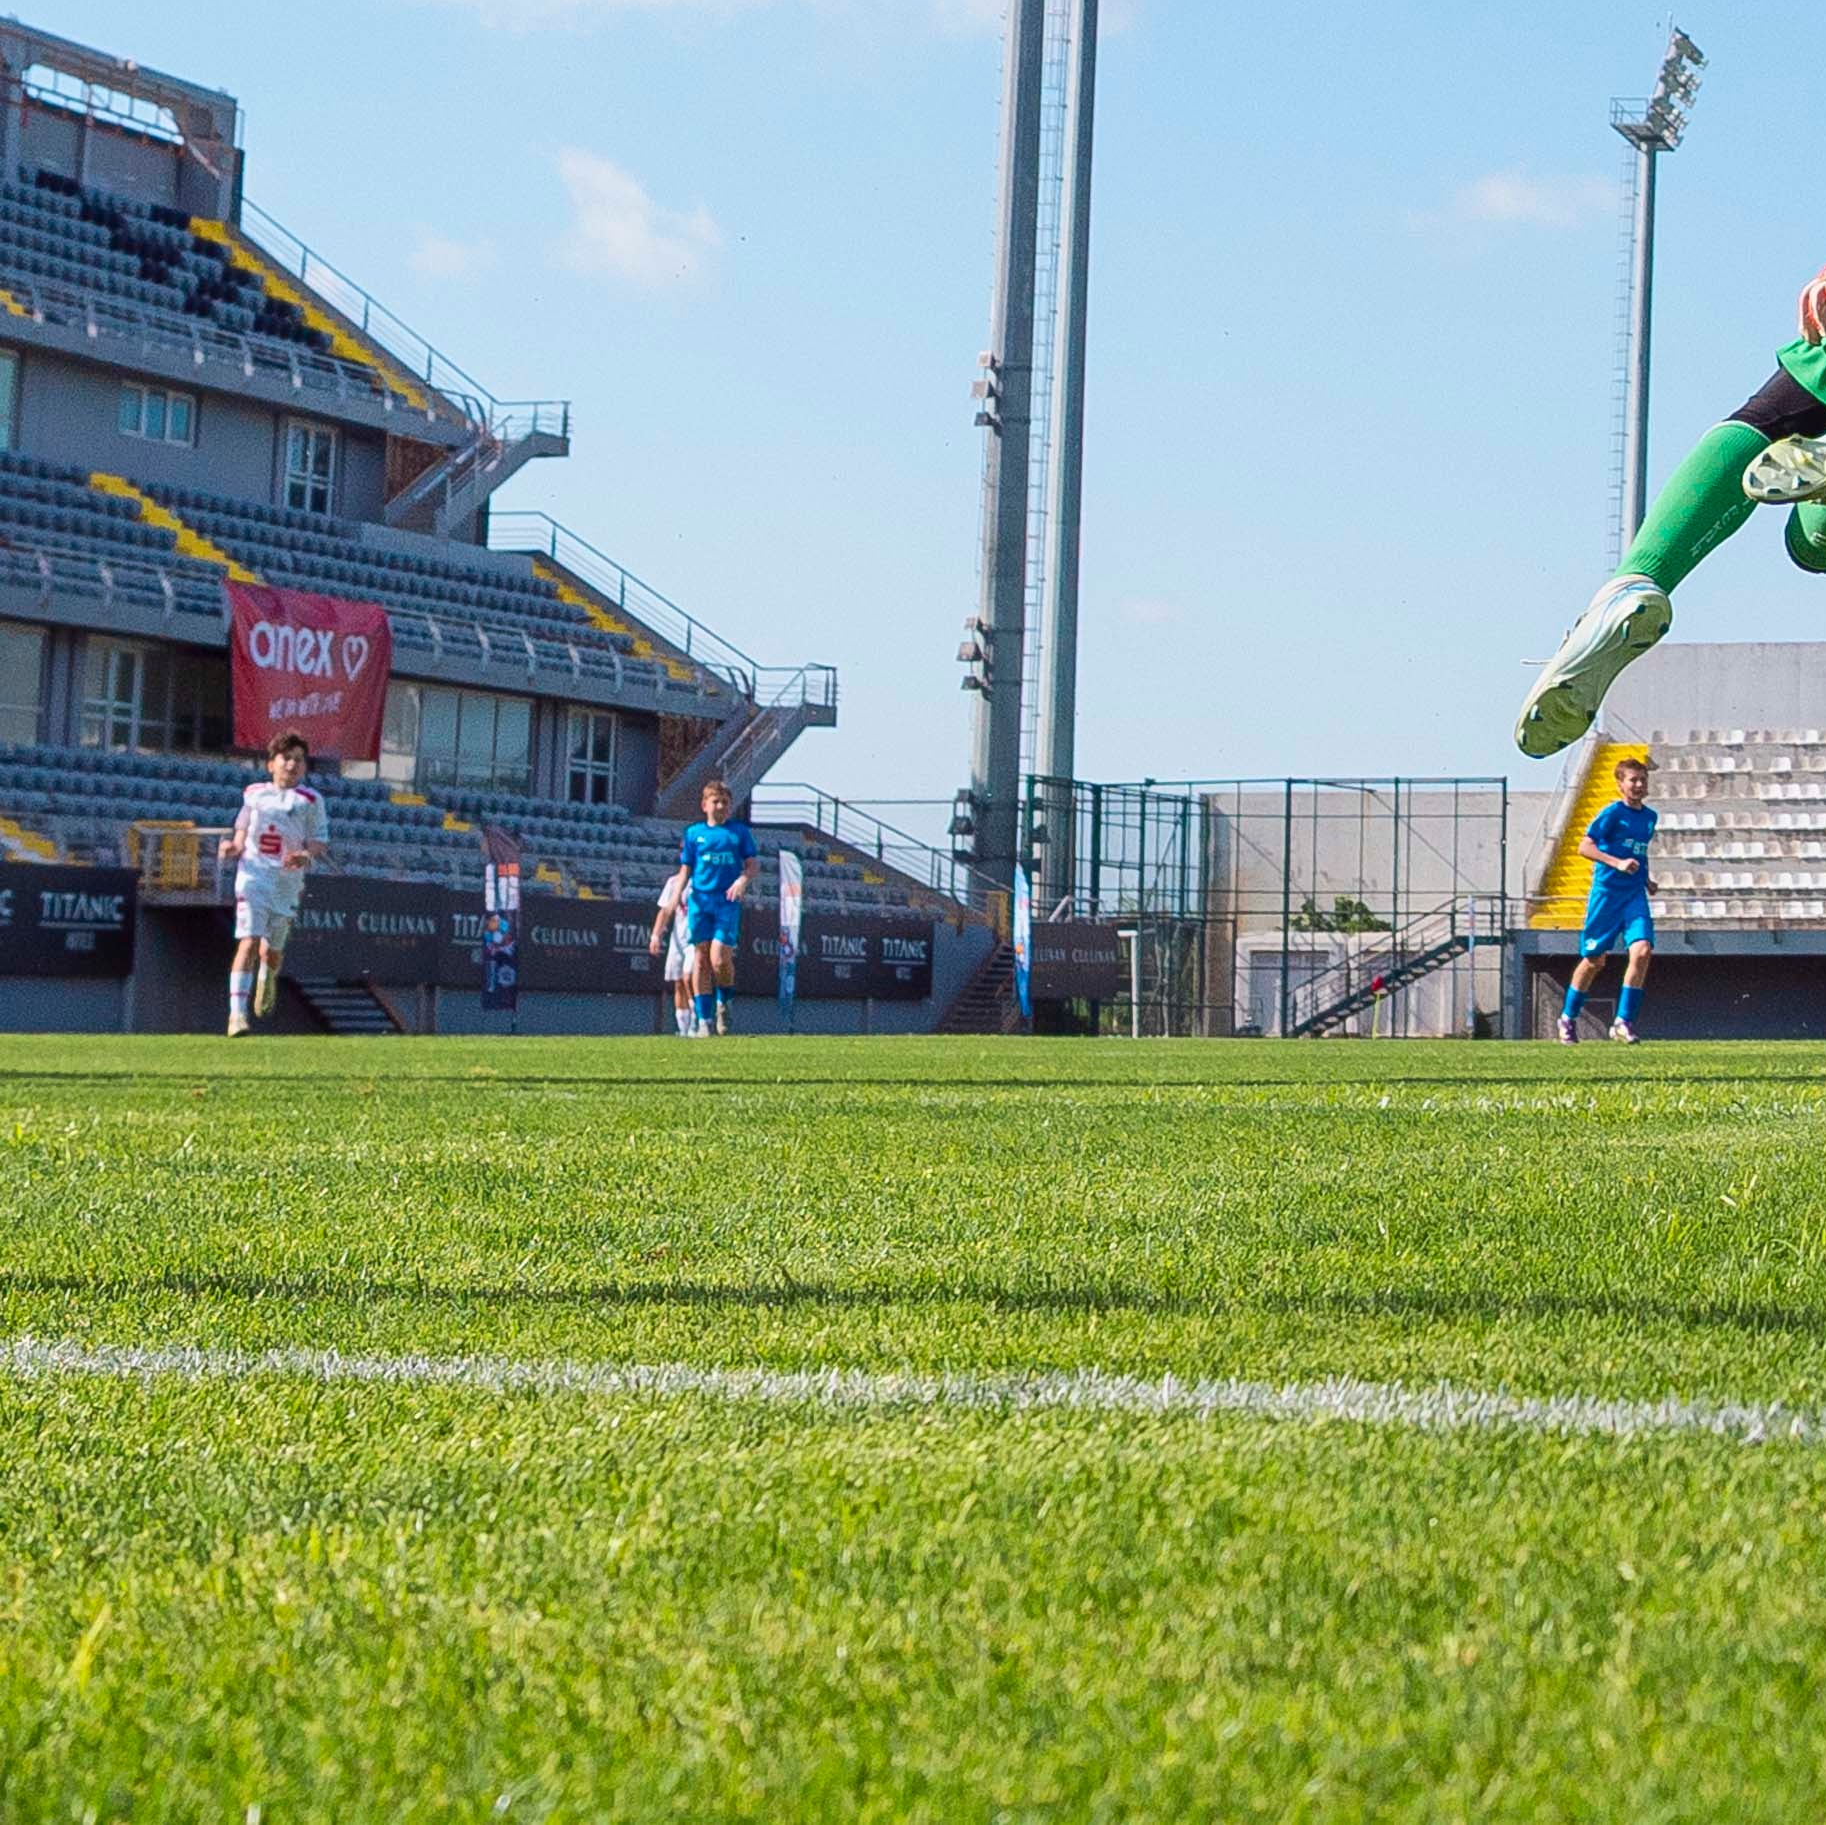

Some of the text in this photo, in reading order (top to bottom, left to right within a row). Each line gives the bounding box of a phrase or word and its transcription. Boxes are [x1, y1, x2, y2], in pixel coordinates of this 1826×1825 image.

[249, 620, 334, 679] anex
[40, 891, 124, 922] TITANIC
[820, 934, 867, 956] TITANIC
[882, 938, 928, 959] TITANIC
